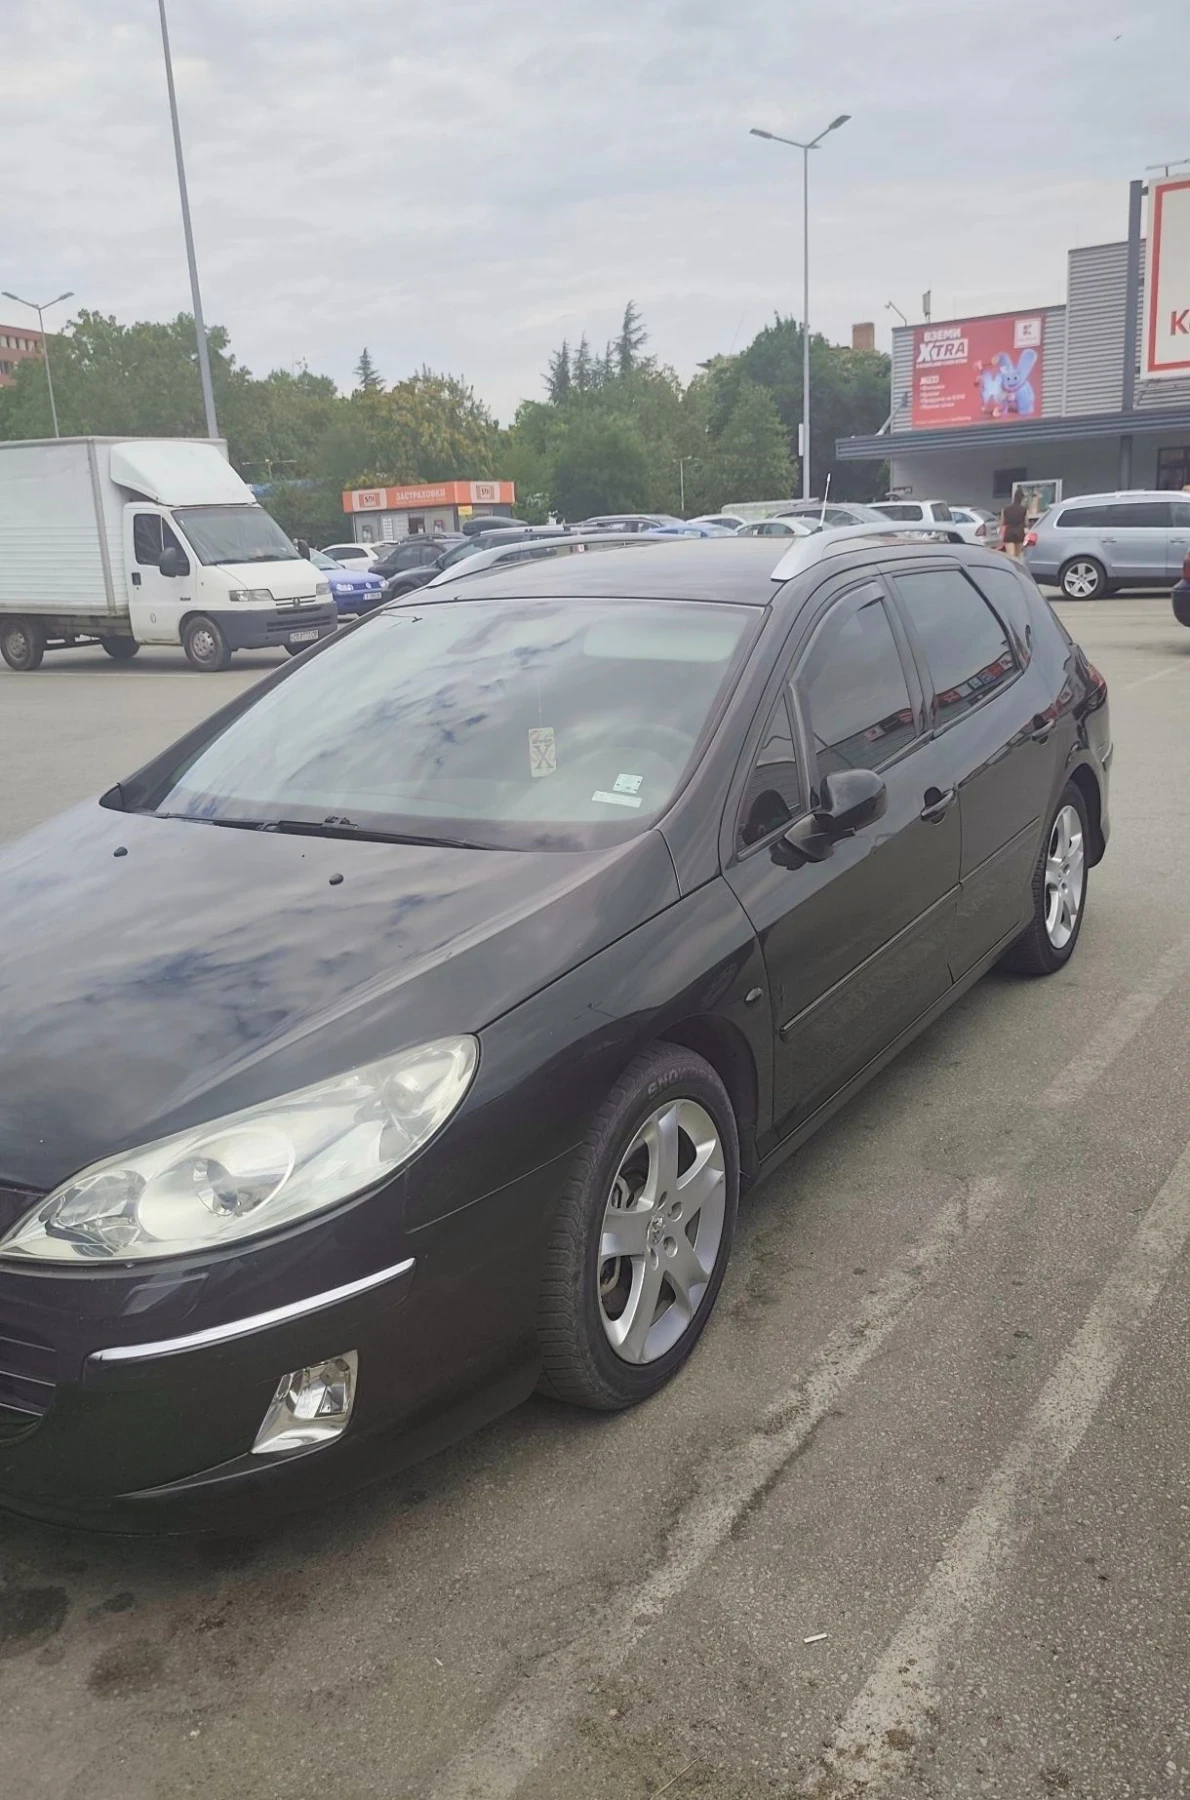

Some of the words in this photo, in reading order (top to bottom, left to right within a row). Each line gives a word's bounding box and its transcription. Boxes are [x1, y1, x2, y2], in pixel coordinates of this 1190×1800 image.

[1170, 308, 1190, 337] K
[924, 328, 961, 342] ВЗЕМИ
[916, 341, 967, 363] XTRA
[396, 487, 447, 500] ЗАСТРАХОВКИ
